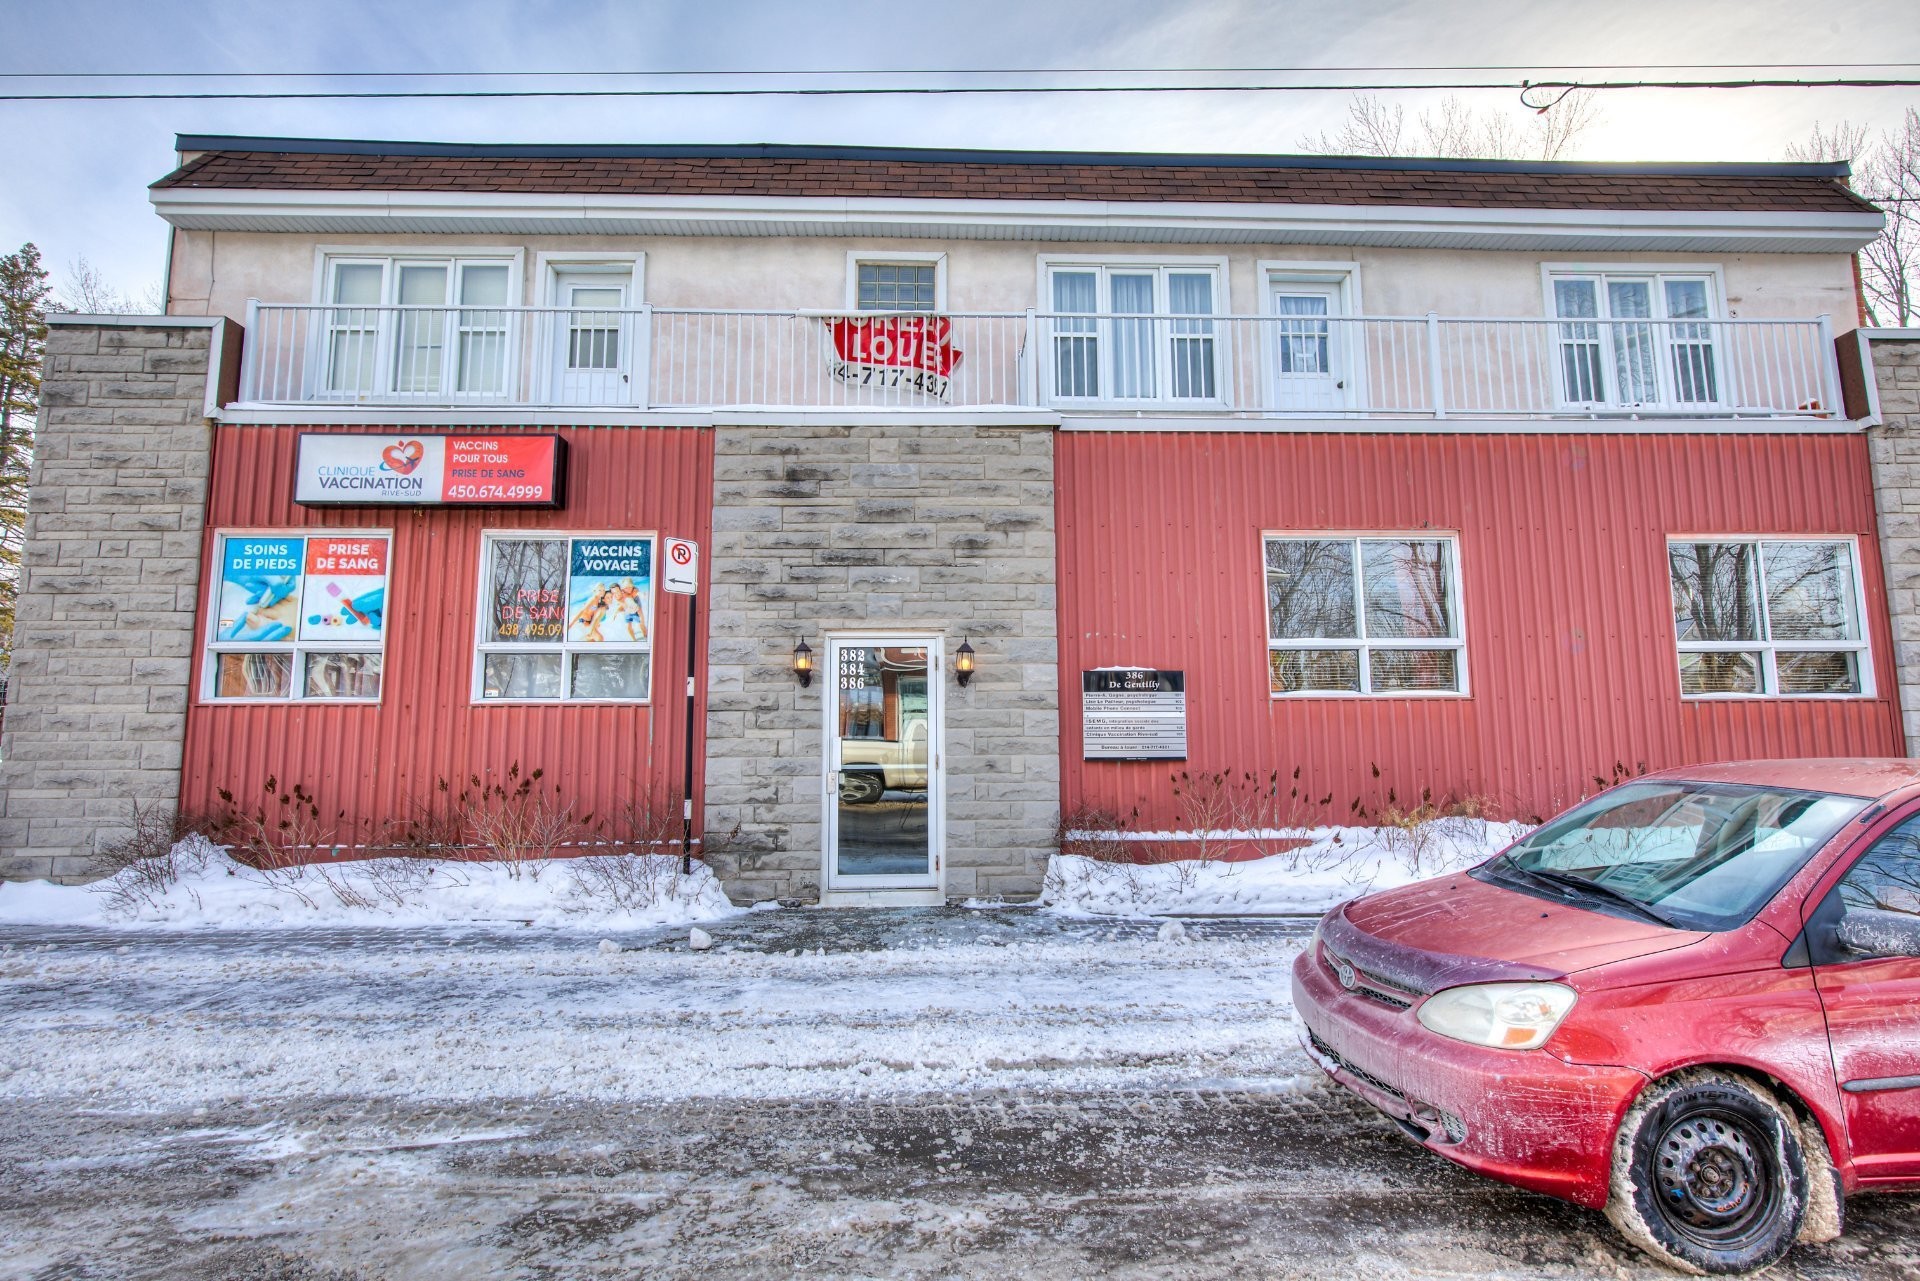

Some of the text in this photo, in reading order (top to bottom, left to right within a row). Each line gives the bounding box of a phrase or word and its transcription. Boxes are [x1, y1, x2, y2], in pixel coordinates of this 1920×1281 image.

[453, 441, 498, 450] VACCINS
[453, 454, 509, 463] POUR TOUS
[318, 466, 376, 476] CLINIQUE
[452, 469, 525, 478] PRISE DE SANG
[319, 477, 423, 489] VACCINATION
[448, 485, 543, 498] 450.674.4999
[244, 544, 288, 555] SOINS
[328, 544, 369, 555] PRISE
[581, 545, 642, 557] VACCINS
[233, 559, 297, 569] DE PIEDS
[317, 558, 379, 569] DE SANG
[583, 559, 639, 571] VOYAGE
[517, 589, 559, 603] PRISE
[502, 605, 523, 619] DE
[841, 649, 865, 661] 382
[840, 662, 865, 675] 384
[1125, 671, 1144, 680] 386
[840, 676, 864, 689] 386
[1109, 680, 1160, 691] De Gentilly
